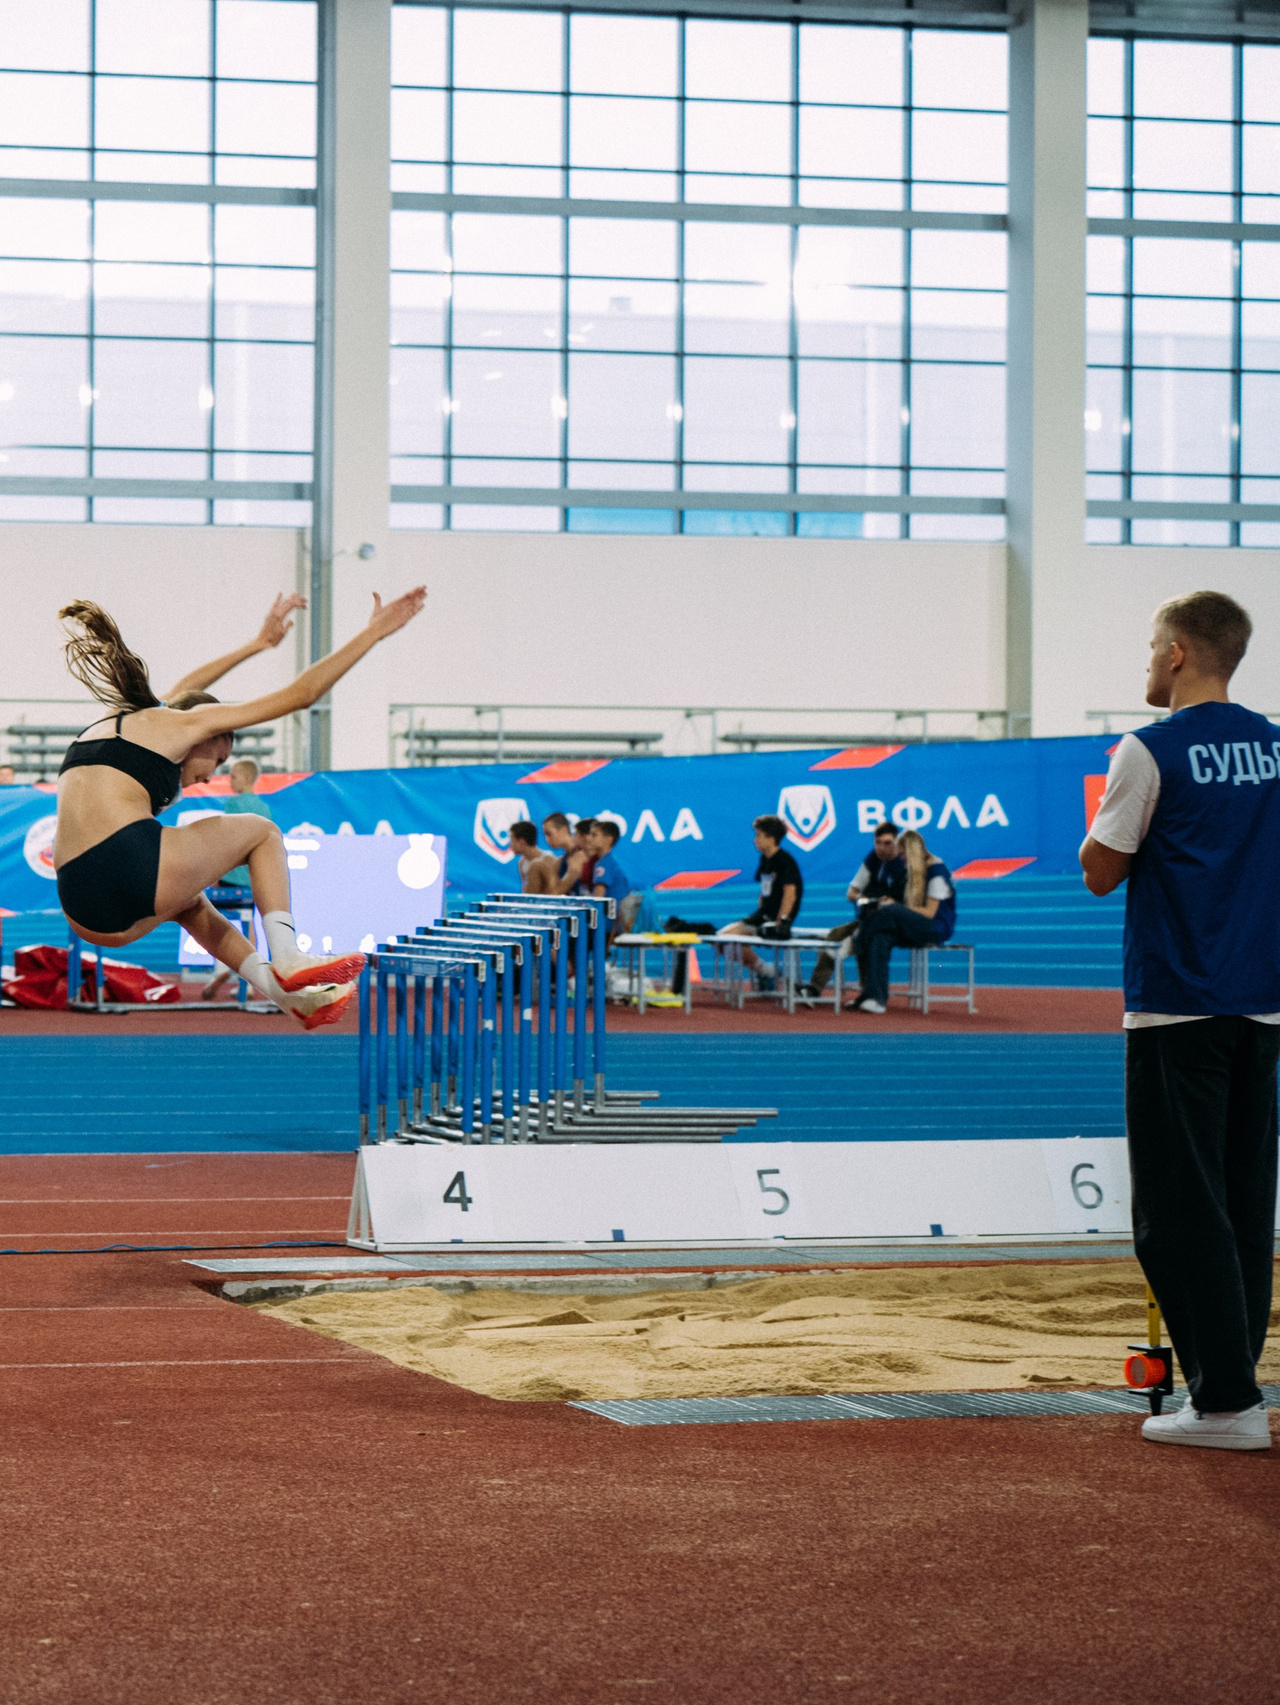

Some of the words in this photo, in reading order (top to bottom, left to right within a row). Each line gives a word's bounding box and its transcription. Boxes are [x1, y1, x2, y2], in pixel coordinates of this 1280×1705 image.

[857, 793, 1009, 833] ВФЛА
[442, 1170, 473, 1212] 4
[756, 1168, 790, 1216] 5
[1070, 1162, 1104, 1210] 6
